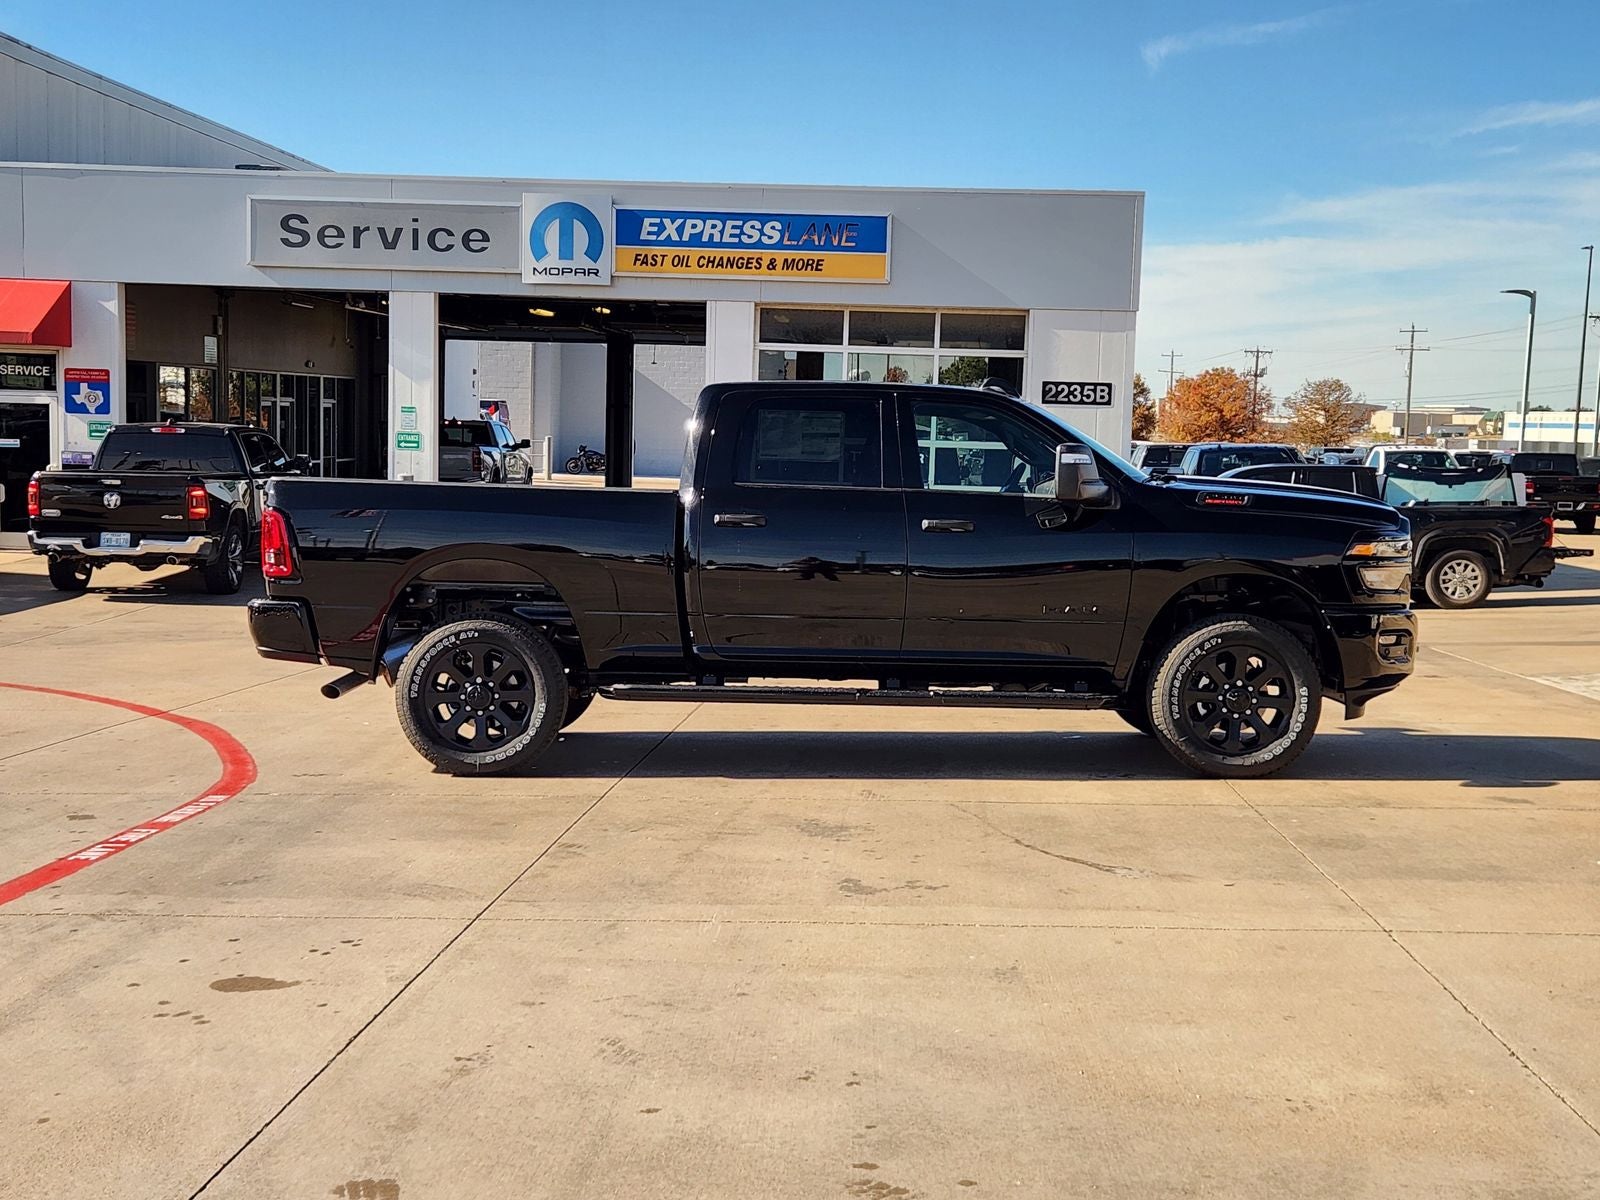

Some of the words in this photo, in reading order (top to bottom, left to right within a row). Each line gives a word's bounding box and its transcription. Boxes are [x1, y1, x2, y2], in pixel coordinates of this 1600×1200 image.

[280, 213, 491, 253] Service
[633, 253, 668, 267] FAST
[671, 254, 692, 268] OIL
[697, 255, 763, 270] CHANGES
[766, 257, 778, 271] &
[781, 258, 825, 272] MORE
[533, 267, 602, 278] MOPAR
[0, 364, 51, 376] SERVICE
[1044, 384, 1109, 403] 2235B
[410, 634, 456, 698] TRANSFORCE
